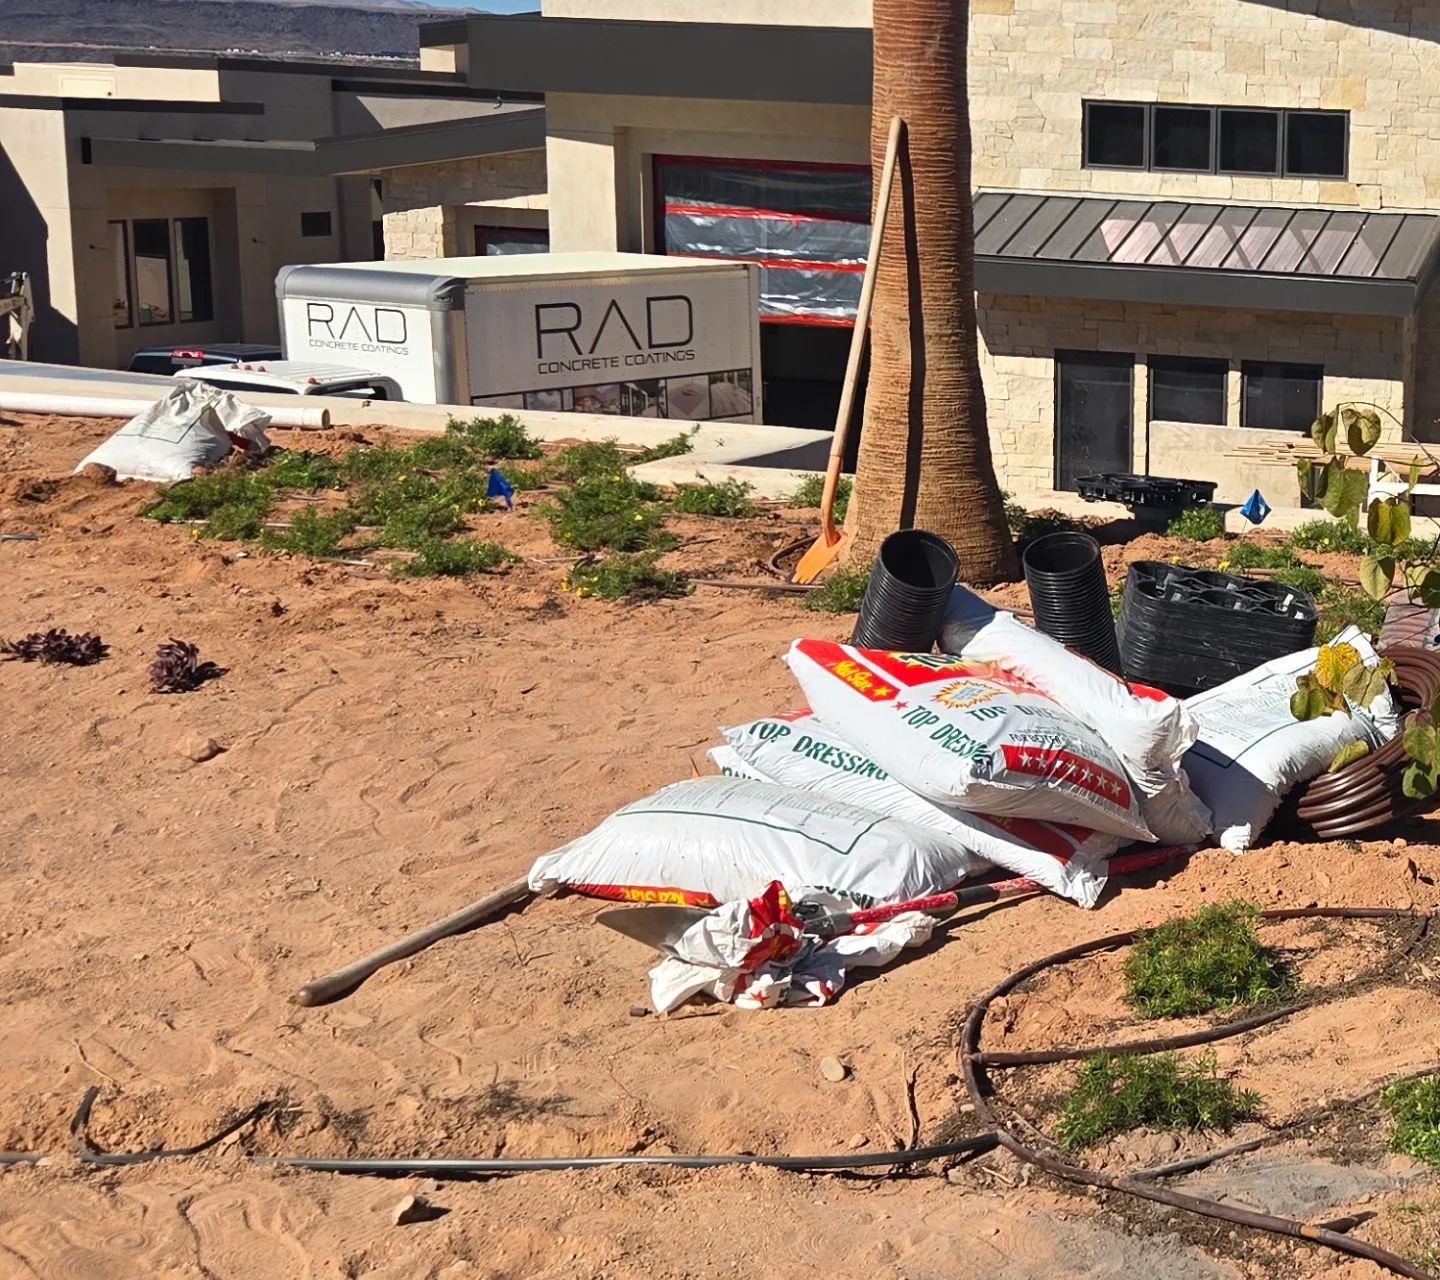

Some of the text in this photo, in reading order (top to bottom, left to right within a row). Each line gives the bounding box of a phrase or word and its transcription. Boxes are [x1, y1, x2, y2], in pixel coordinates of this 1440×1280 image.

[307, 303, 407, 344] RAD
[535, 295, 693, 359] RAD
[309, 339, 409, 356] CONCRETE COATINGS
[538, 349, 695, 374] CONCRETE COATINGS
[902, 705, 940, 729] TOP
[749, 721, 791, 743] TOP
[792, 735, 889, 782] DRESSING
